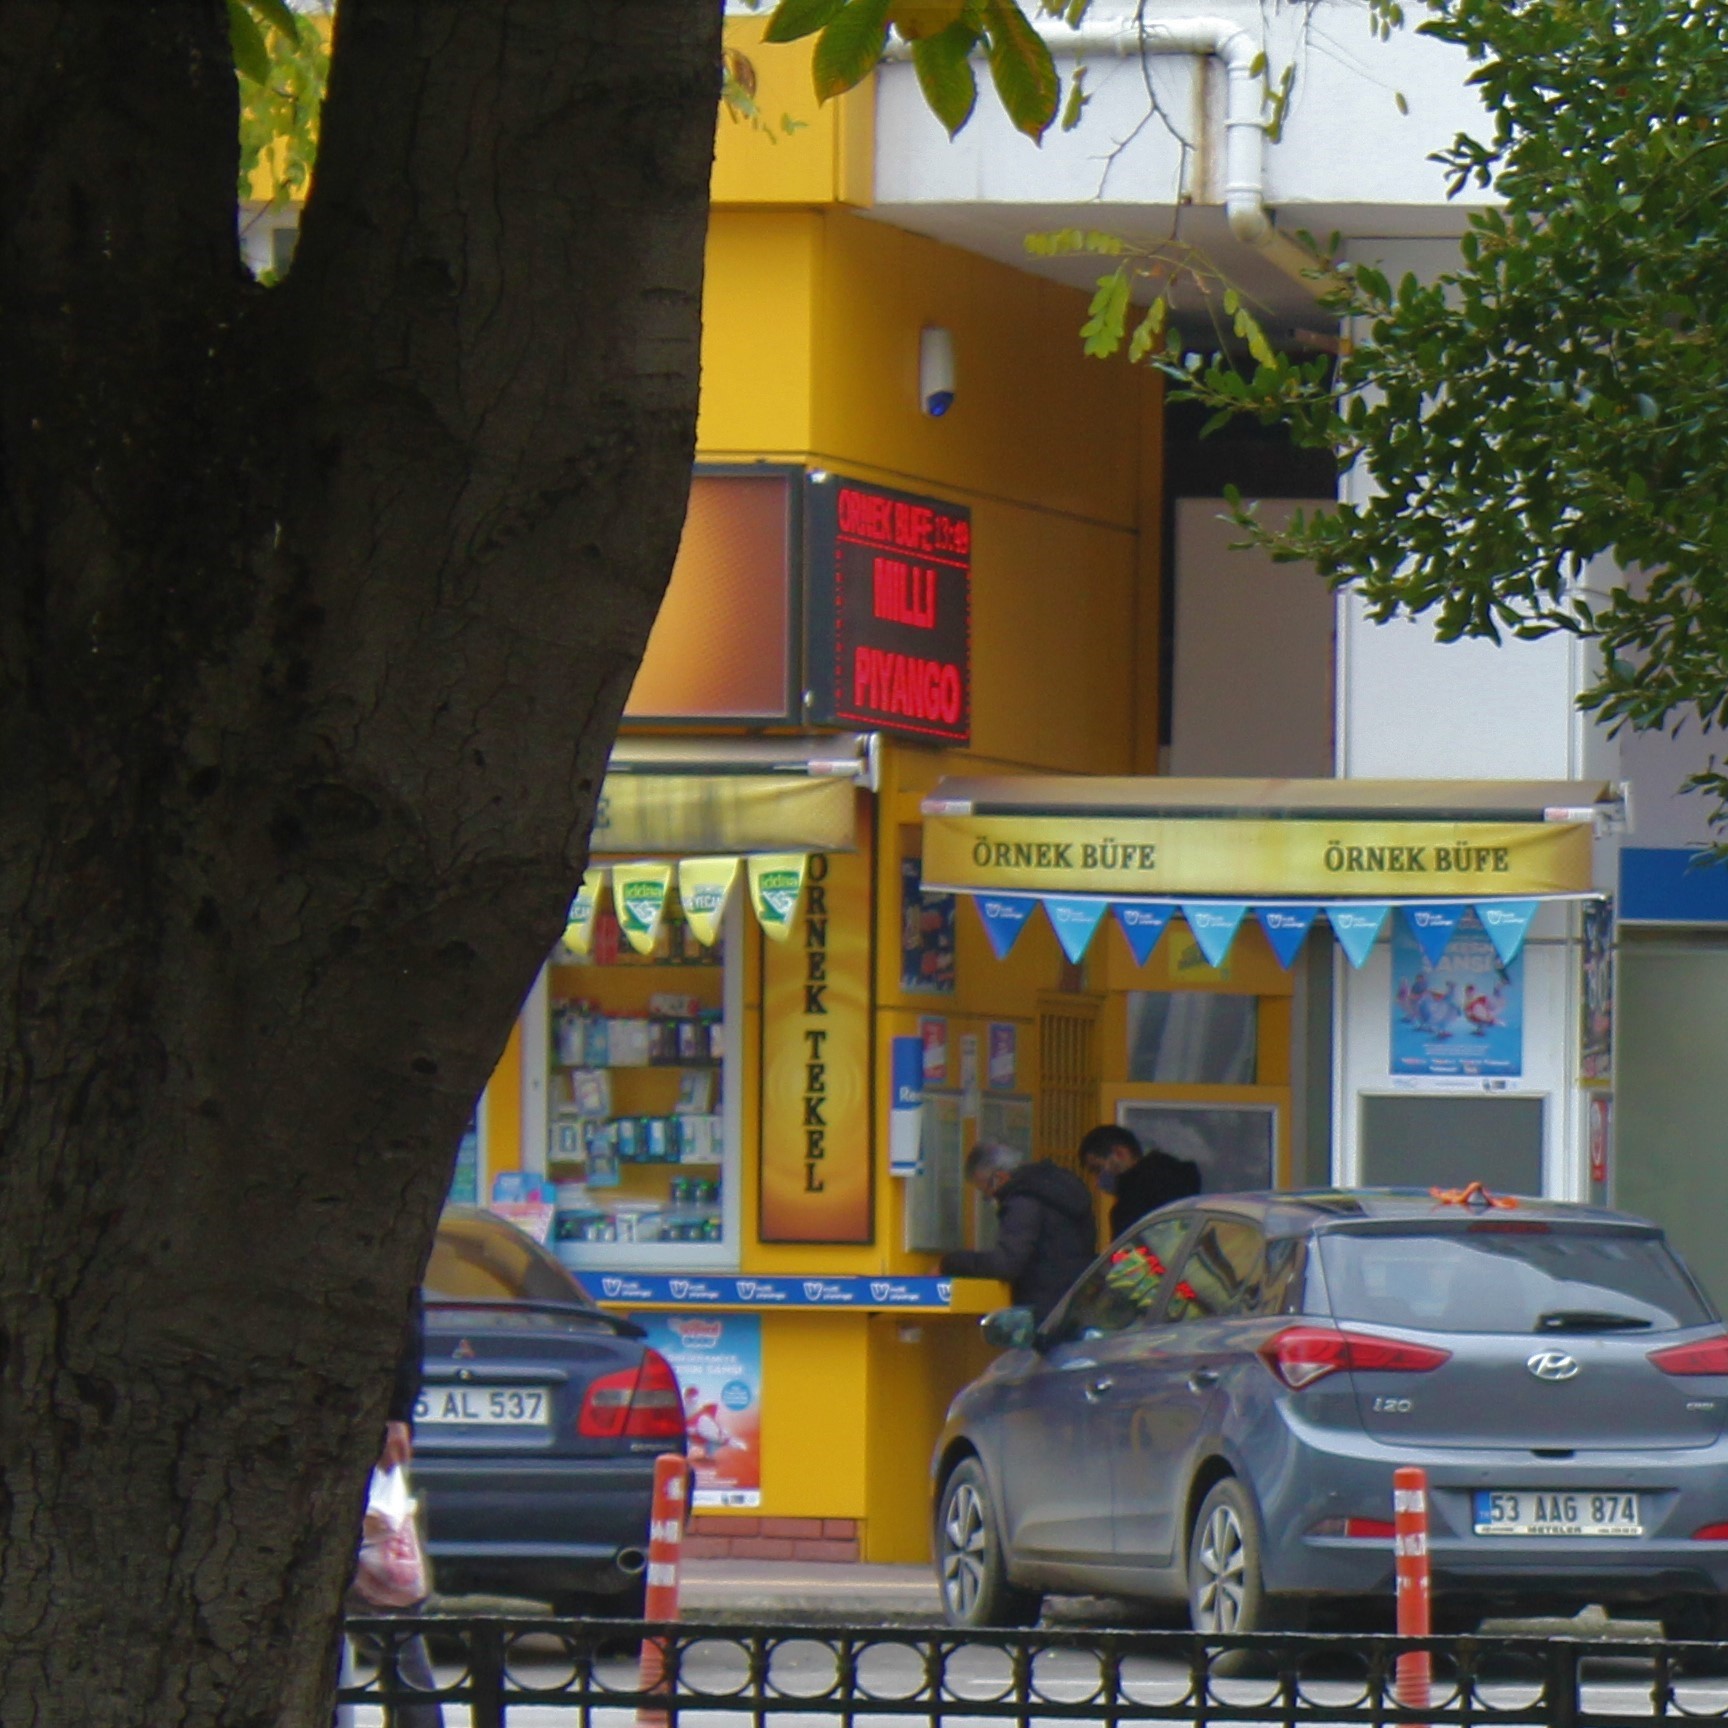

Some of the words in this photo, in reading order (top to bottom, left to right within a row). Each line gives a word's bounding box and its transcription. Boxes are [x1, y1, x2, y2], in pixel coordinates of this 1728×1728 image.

[973, 836, 1073, 868] ÖRNEK
[1081, 838, 1156, 870] BÜFE
[1324, 840, 1427, 873] ÖRNEK
[1434, 841, 1509, 873] BÜFE
[803, 1030, 827, 1193] TEKEL
[442, 1391, 480, 1419] AL
[490, 1392, 543, 1420] 537
[1491, 1495, 1520, 1523] 53
[1534, 1495, 1578, 1523] AAG
[1591, 1495, 1636, 1524] 874
